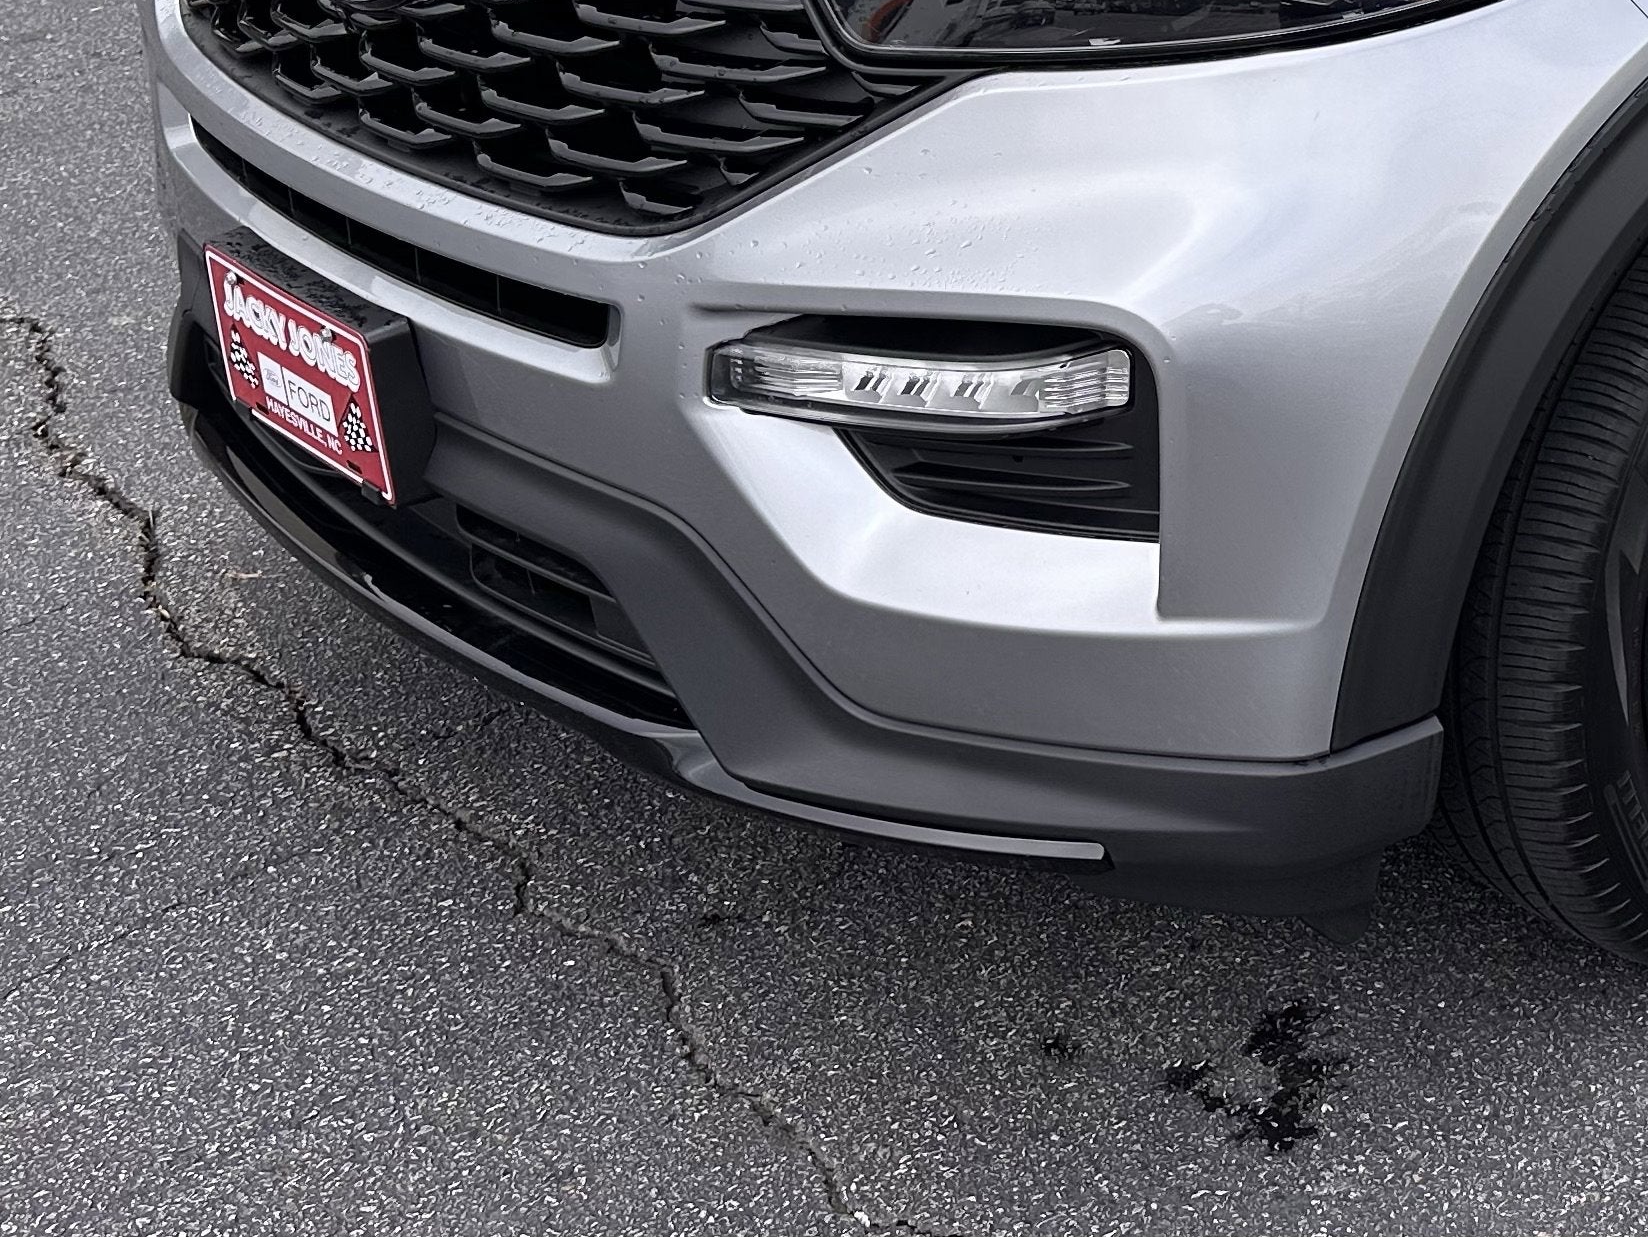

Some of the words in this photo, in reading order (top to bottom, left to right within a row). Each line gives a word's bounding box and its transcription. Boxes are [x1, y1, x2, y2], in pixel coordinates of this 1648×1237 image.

[223, 275, 287, 351] JACKY
[288, 319, 360, 393] JONES
[266, 395, 327, 447] HAYESVILLE,
[326, 433, 343, 455] NC
[288, 380, 331, 422] FORD
